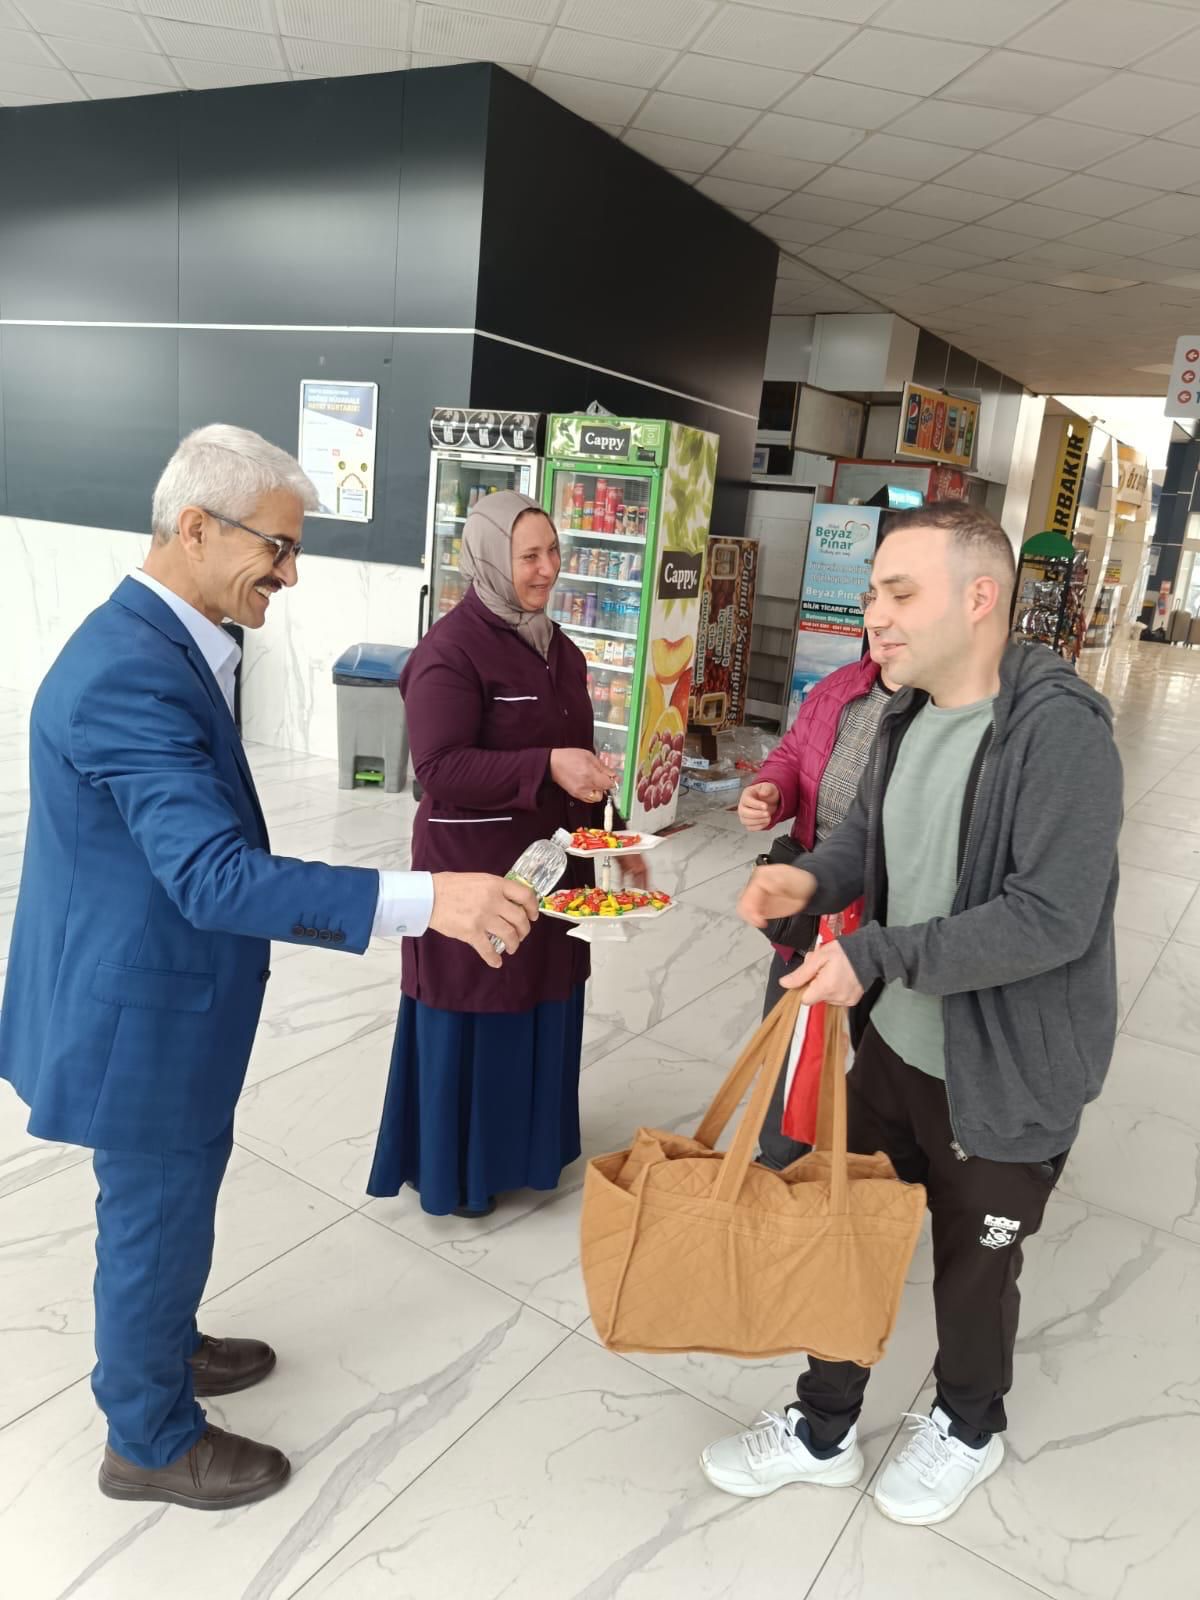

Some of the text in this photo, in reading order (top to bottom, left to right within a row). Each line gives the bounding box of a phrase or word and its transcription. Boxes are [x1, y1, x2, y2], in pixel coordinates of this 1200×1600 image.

[585, 431, 625, 450] Cappy
[816, 526, 853, 540] Beyaz
[820, 538, 854, 550] Pınar
[664, 562, 697, 590] Cappy
[738, 550, 754, 619] Damak
[806, 586, 835, 599] Beyaz
